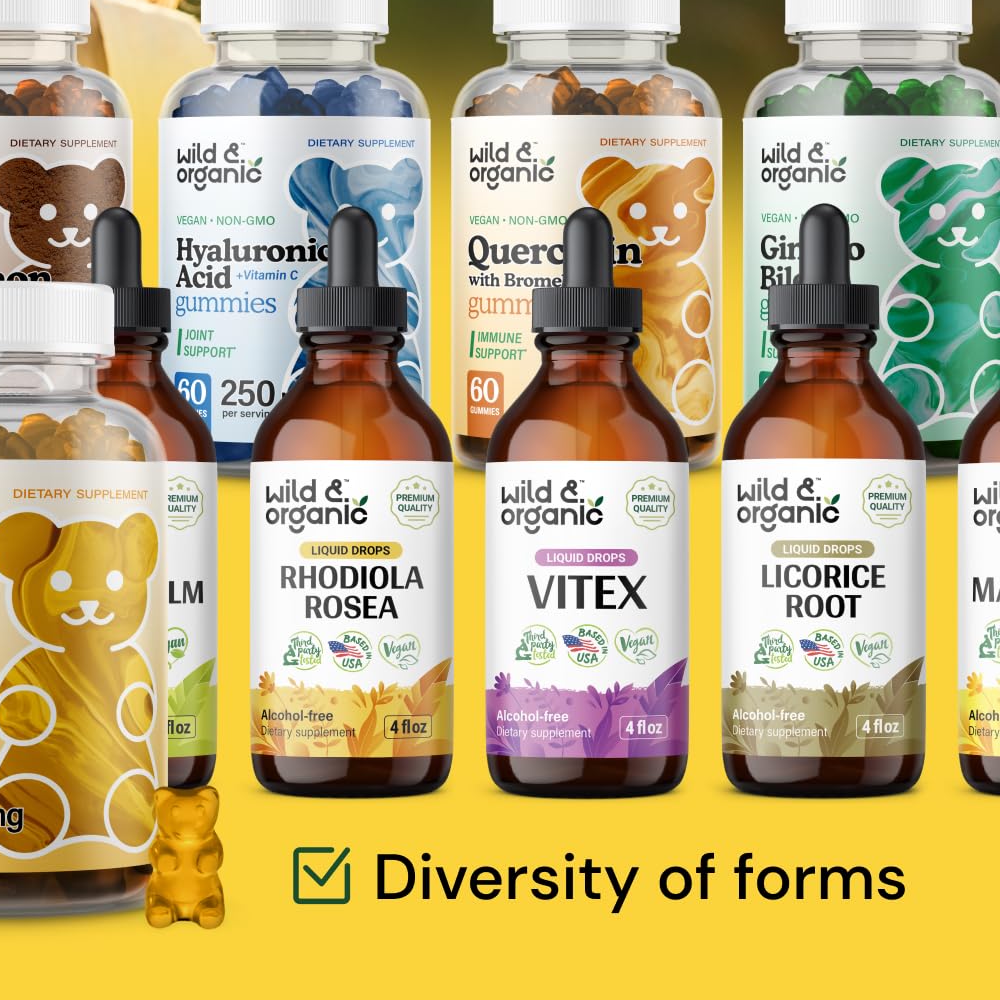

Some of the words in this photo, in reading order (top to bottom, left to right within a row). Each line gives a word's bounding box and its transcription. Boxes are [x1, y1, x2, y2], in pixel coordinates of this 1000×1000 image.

[10, 139, 56, 147] DIETARY
[60, 139, 117, 148] SUPPLEMENT
[308, 139, 353, 147] DIETARY
[358, 139, 416, 148] SUPPLEMENT
[600, 138, 646, 146] DIETARY
[650, 139, 707, 147] SUPPLEMENT
[900, 139, 945, 147] DIETARY
[949, 139, 1000, 147] SUPPLEMEN
[177, 143, 216, 164] wild
[224, 143, 239, 164] &
[177, 159, 262, 191] organic
[177, 216, 206, 225] VEGAN
[216, 216, 275, 225] NON-GMO
[470, 216, 499, 225] VEGAN
[509, 216, 567, 225] NON-GMO
[176, 237, 329, 267] Hyaluronic
[176, 264, 232, 289] Acid
[236, 270, 287, 281] +Vitamin
[290, 271, 298, 281] C
[469, 273, 499, 287] with
[176, 292, 277, 317] gummies
[185, 329, 214, 341] JOINT
[478, 332, 522, 343] IMMUNE
[220, 380, 275, 406] 250
[470, 377, 499, 403] 60
[222, 410, 237, 419] per
[470, 406, 500, 416] GUMMIES
[13, 489, 71, 499] DIETARY
[76, 489, 148, 500] SUPPLEMENT
[266, 479, 316, 502] wild
[325, 479, 342, 502] &
[501, 480, 551, 503] wild
[560, 480, 578, 503] &
[738, 478, 788, 501] wild
[797, 477, 814, 501] &
[396, 494, 435, 502] PREMIUM
[632, 494, 670, 503] PREMIUM
[868, 492, 907, 501] PREMIUM
[398, 504, 433, 512] QUALITY
[633, 505, 668, 513] QUALITY
[870, 503, 905, 511] QUALITY
[266, 497, 368, 534] organic
[501, 498, 603, 534] organic
[737, 496, 840, 532] organic
[312, 546, 348, 556] LIQUID
[352, 546, 390, 556] DROPS
[783, 544, 820, 555] LIQUID
[824, 544, 863, 554] DROPS
[547, 553, 584, 563] LIQUID
[587, 553, 626, 563] DROPS
[280, 566, 424, 590] RHODIOLA
[761, 565, 886, 588] LICORICE
[527, 575, 647, 610] VITEX
[305, 595, 398, 620] ROSEA
[786, 595, 862, 618] ROOT
[620, 635, 655, 654] Vegan
[577, 653, 598, 664] USA
[261, 710, 334, 722] Alcohol-free
[497, 710, 569, 722] Alcohol-free
[261, 726, 292, 738] Dietary
[296, 727, 356, 738] supplement
